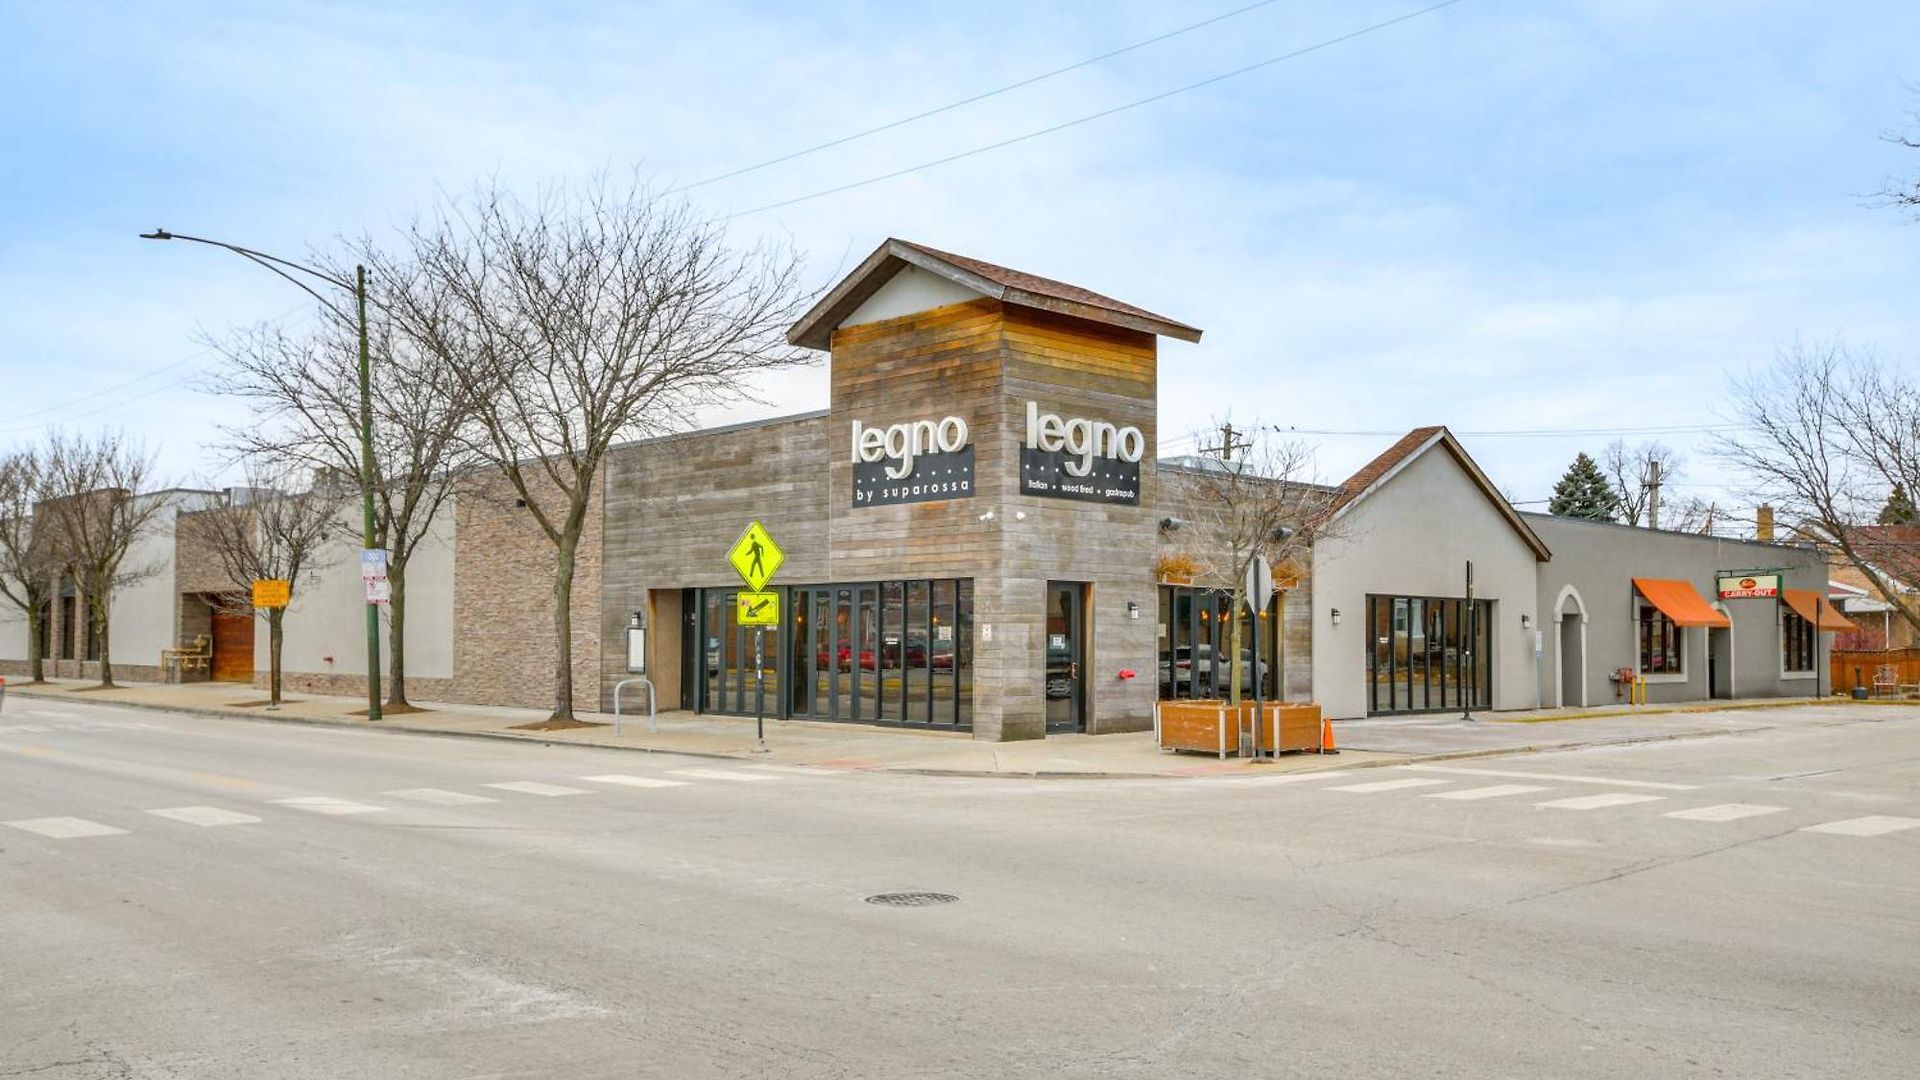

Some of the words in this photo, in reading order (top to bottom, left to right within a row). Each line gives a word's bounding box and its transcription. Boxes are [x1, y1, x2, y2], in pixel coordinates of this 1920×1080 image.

[852, 416, 969, 480] legno
[1026, 401, 1145, 477] legno
[857, 489, 873, 503] by
[883, 479, 969, 499] suparossa
[1062, 484, 1079, 493] wood
[1105, 488, 1135, 499] gastropub
[1724, 589, 1772, 598] CARRY-OUT
